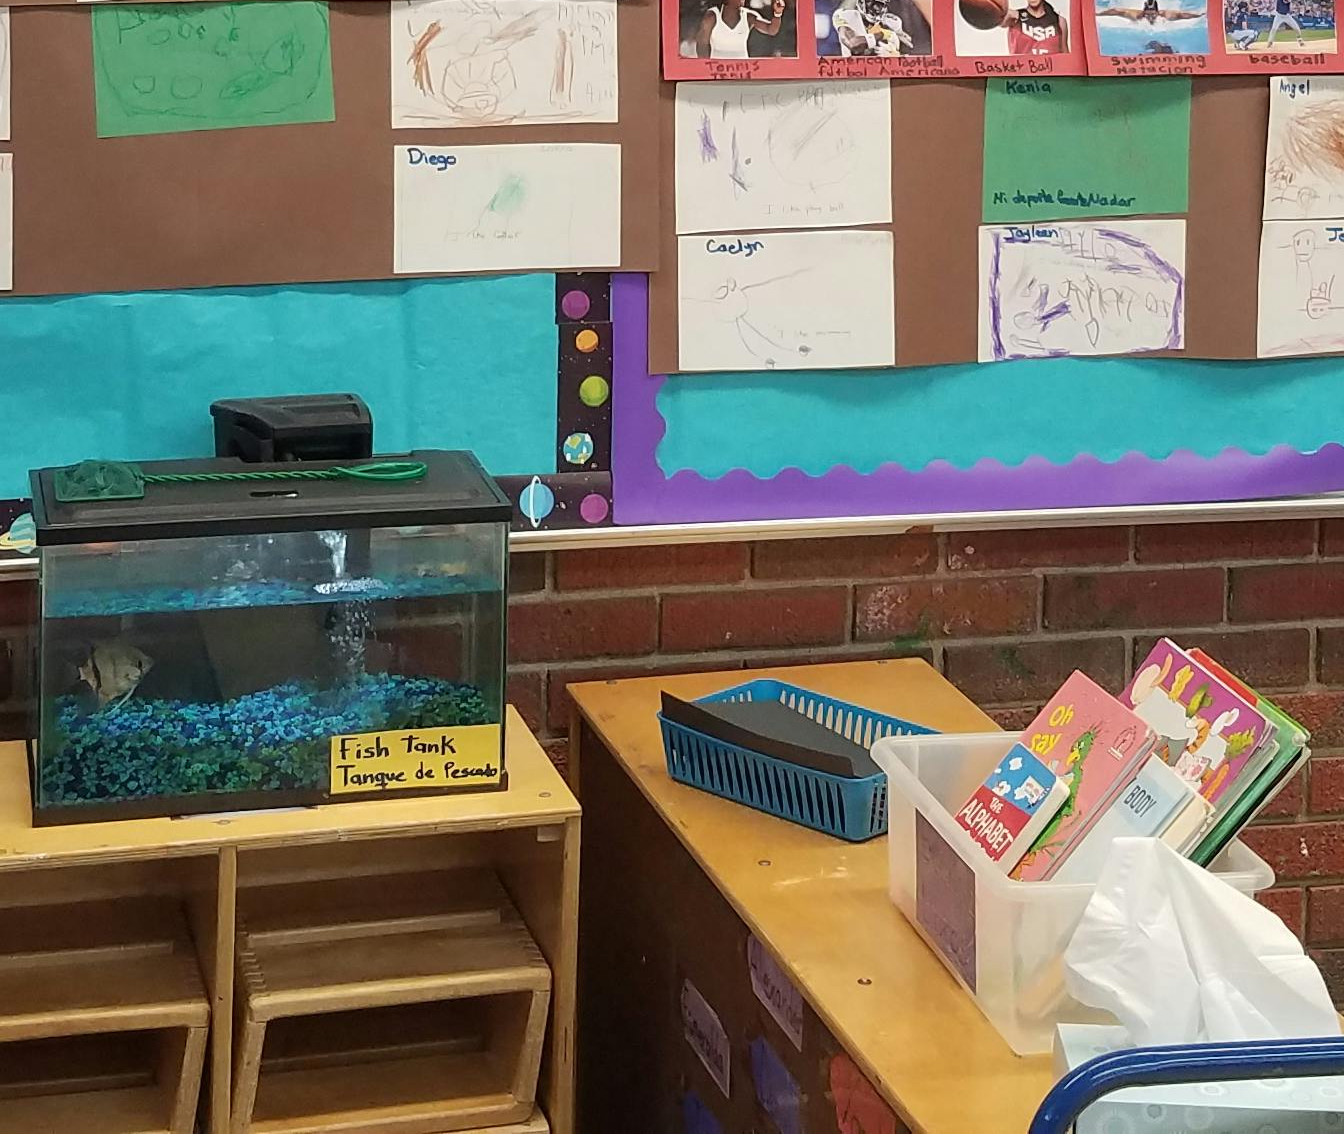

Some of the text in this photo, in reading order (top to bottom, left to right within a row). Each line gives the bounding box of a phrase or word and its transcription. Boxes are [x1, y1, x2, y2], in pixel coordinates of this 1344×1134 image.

[1022, 23, 1057, 43] USA
[704, 60, 761, 72] Tennis
[816, 55, 895, 69] American
[974, 59, 1054, 75] Basket Ball
[1249, 52, 1326, 66] baseball
[1005, 80, 1053, 95] Kenia
[1279, 78, 1310, 99] Angel
[406, 147, 458, 172] Diego
[705, 238, 765, 258] Caelyn
[1048, 704, 1075, 729] Oh
[338, 734, 458, 760] Fish Tank
[1029, 731, 1064, 756] say
[414, 759, 436, 782] de
[988, 796, 1005, 815] THE
[1123, 782, 1158, 819] BODY
[960, 798, 1015, 856] ALPHABET
